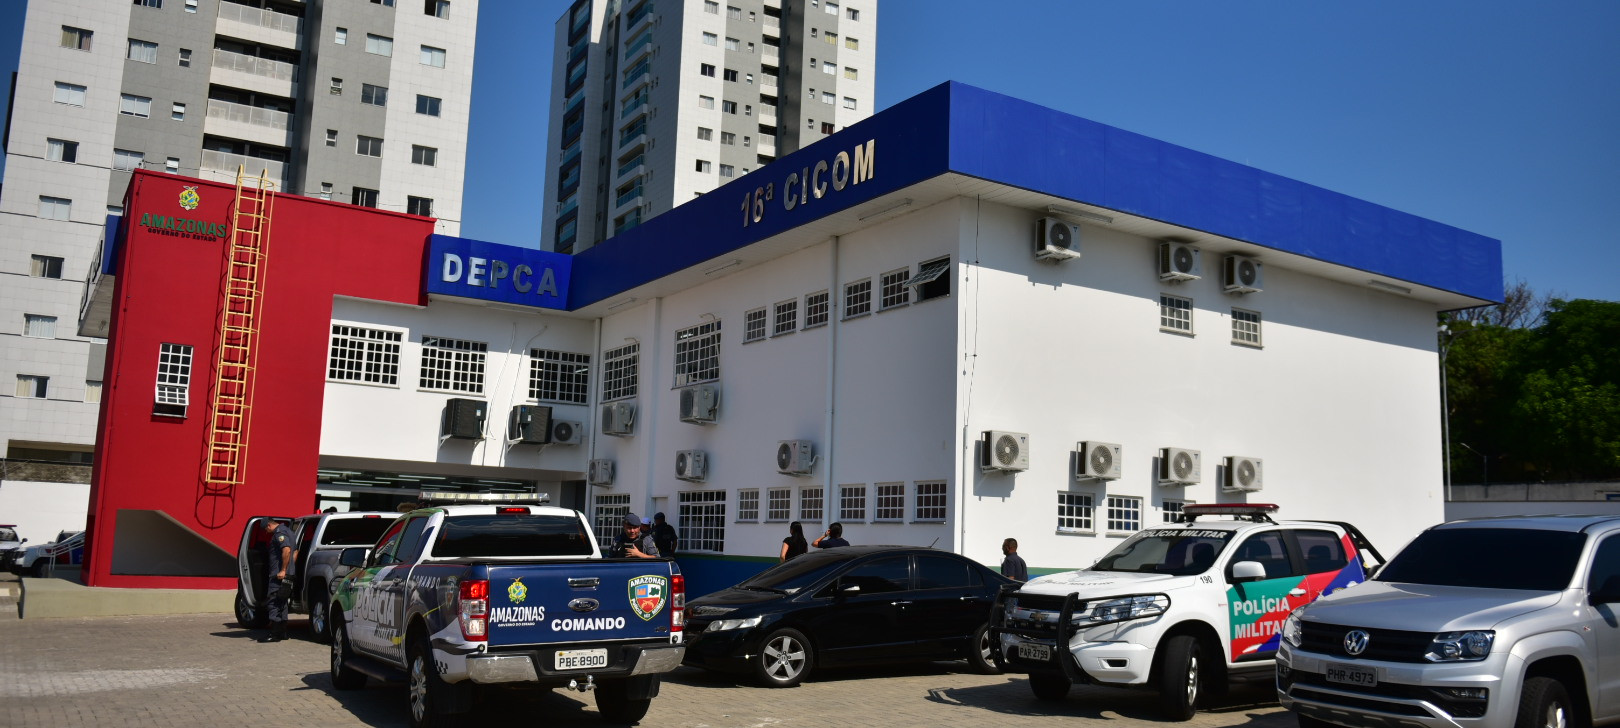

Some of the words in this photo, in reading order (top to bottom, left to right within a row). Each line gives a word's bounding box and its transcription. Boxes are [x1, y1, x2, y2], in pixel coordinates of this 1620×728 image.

[783, 138, 875, 211] CICOM
[140, 212, 227, 238] AMAZONAS
[147, 228, 179, 237] GOVERNO
[192, 233, 217, 242] ESTADO
[443, 253, 558, 297] DEPCA
[1136, 528, 1178, 539] POLÍCIA
[1178, 530, 1228, 539] MILITAR
[630, 577, 666, 588] AMAZONAS
[1200, 575, 1213, 584] 190
[1233, 594, 1291, 617] POLÍCIA
[489, 606, 545, 623] AMAZONAS
[551, 617, 626, 632] COMANDO
[1327, 668, 1374, 684] PHR-4973
